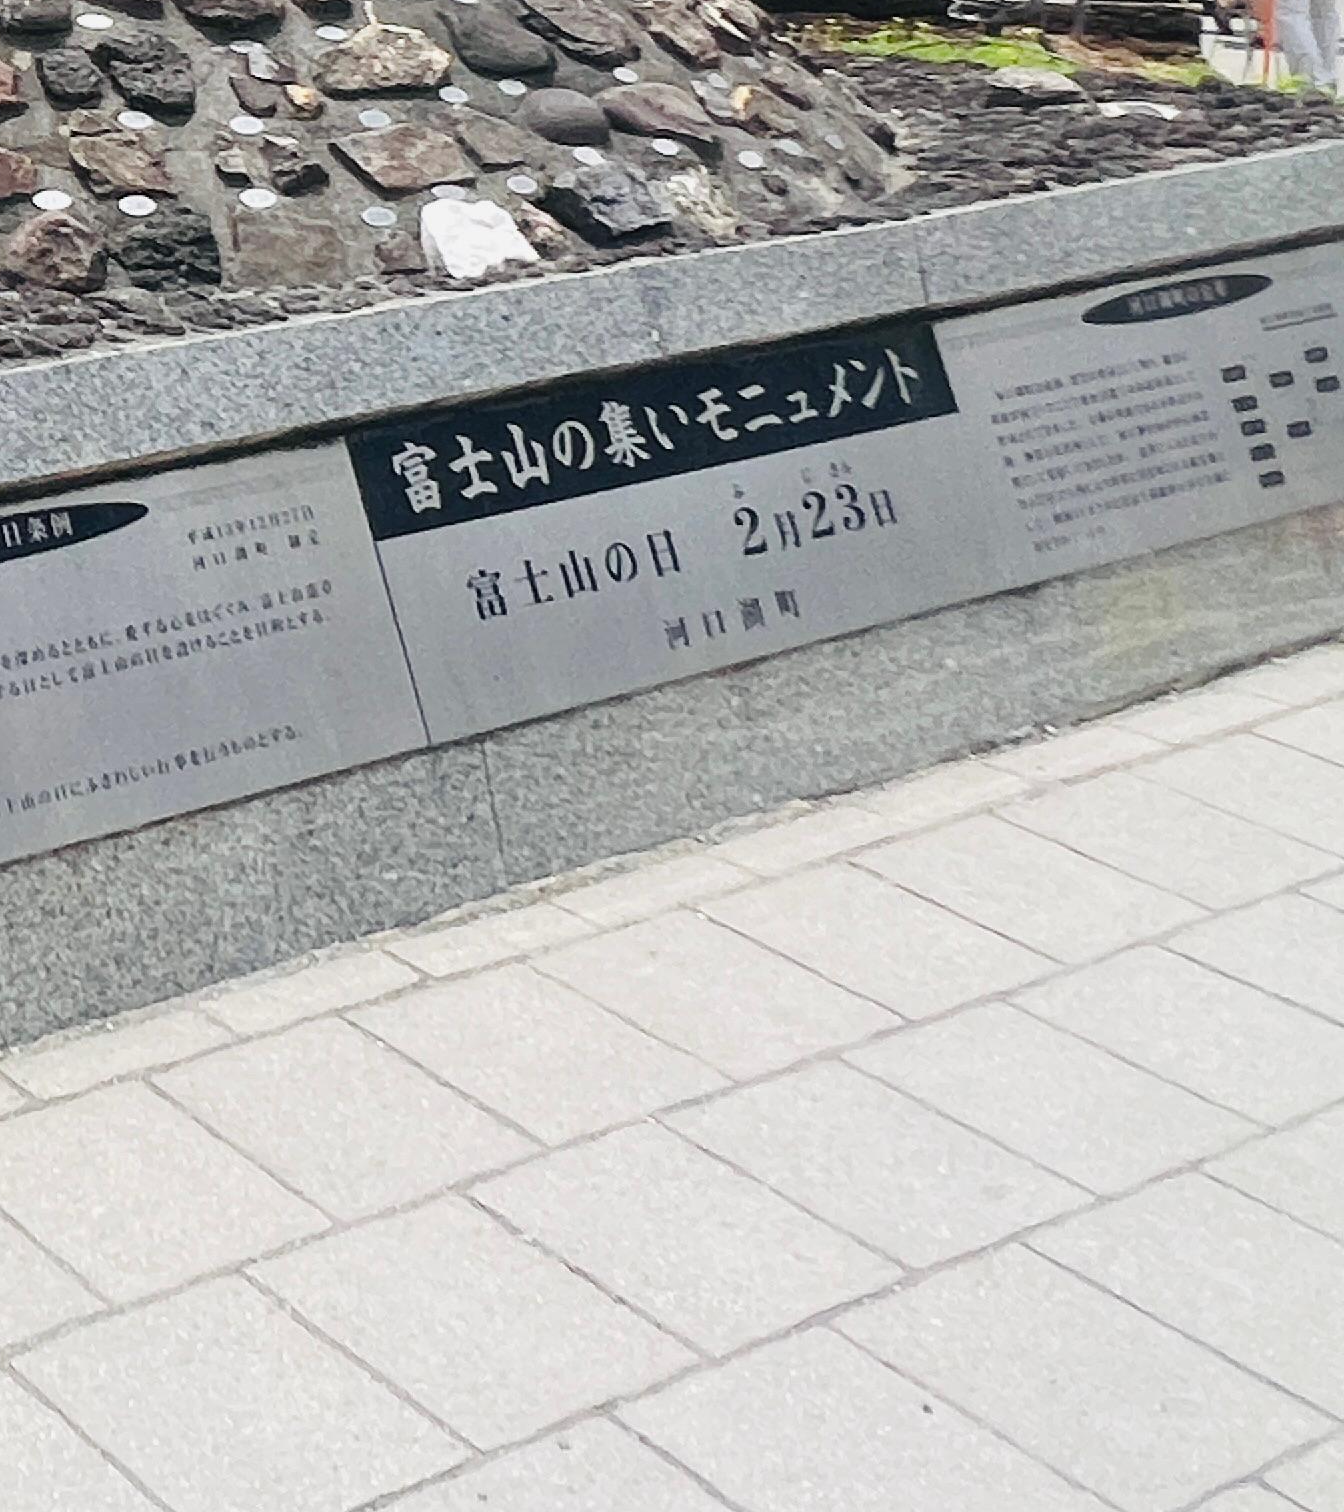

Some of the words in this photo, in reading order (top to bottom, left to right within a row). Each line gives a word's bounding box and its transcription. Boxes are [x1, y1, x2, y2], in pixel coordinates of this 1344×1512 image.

[391, 348, 921, 514] 富士山の集いモニュメント
[467, 529, 681, 620] 富士山の日
[733, 484, 899, 556] 2月23日
[663, 589, 801, 651] 河口湖町
